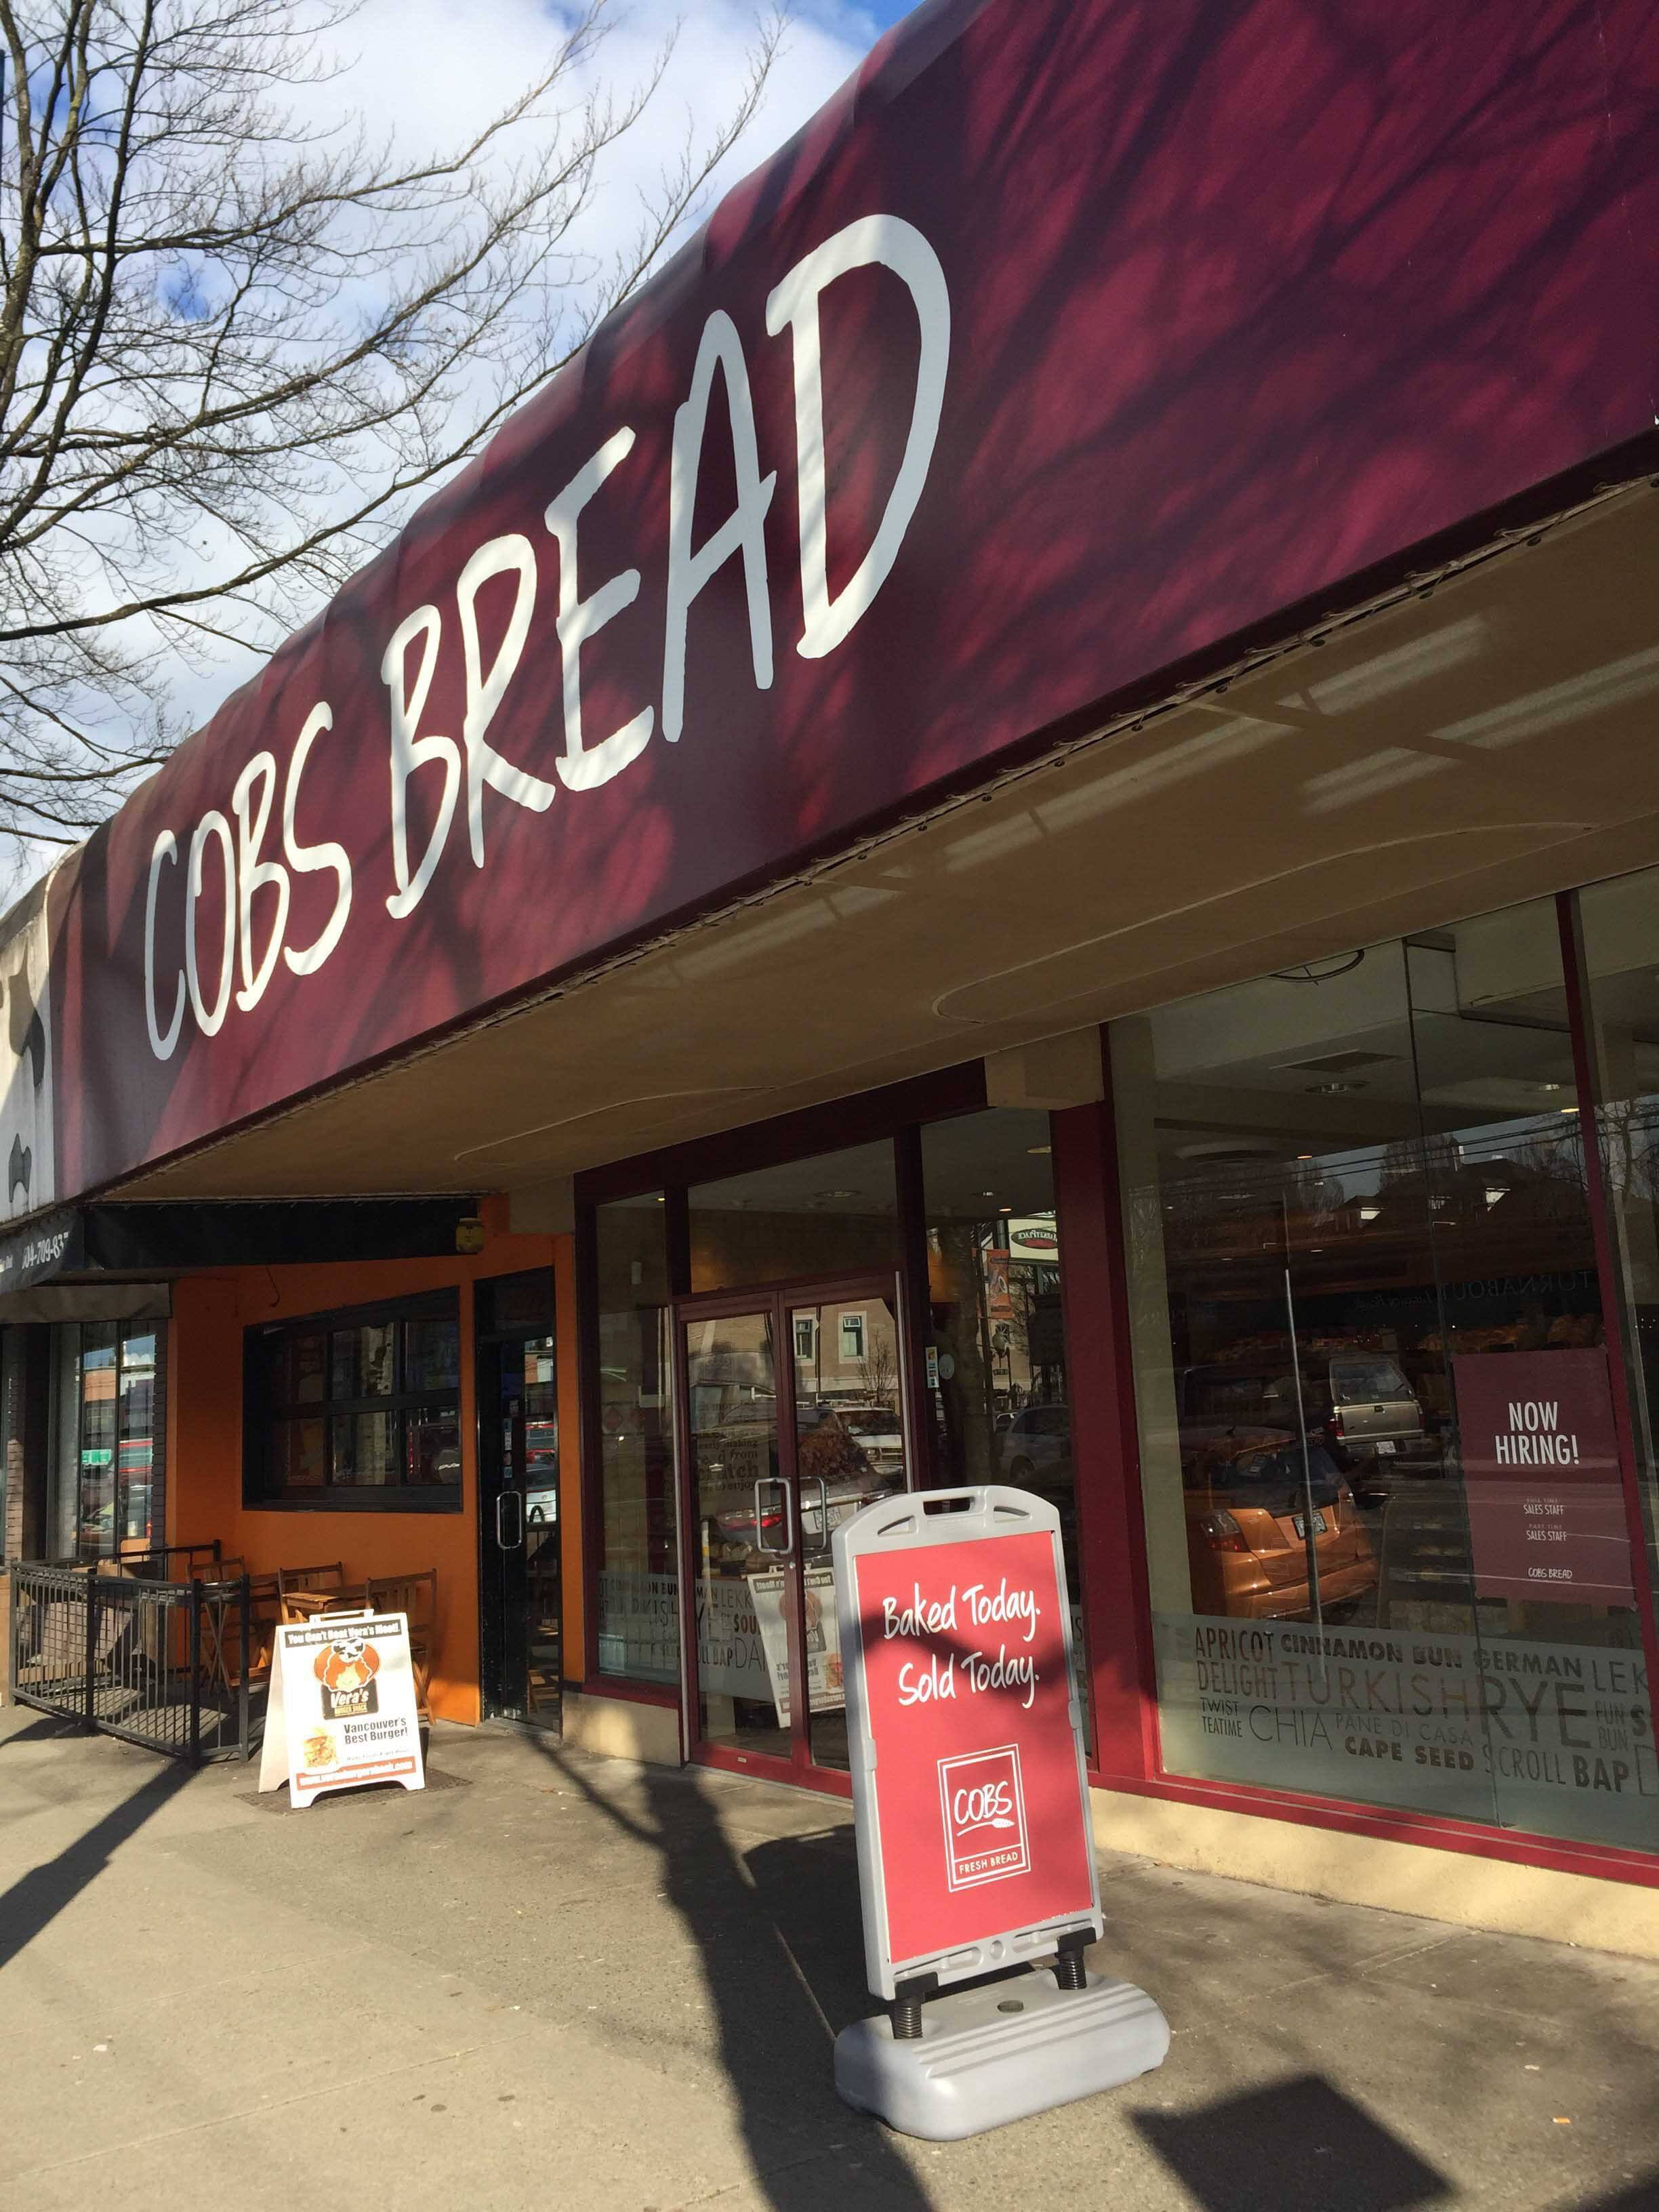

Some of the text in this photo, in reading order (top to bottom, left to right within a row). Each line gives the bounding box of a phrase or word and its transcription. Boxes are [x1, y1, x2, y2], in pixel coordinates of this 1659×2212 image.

[145, 213, 951, 1061] COBS BREAD
[1508, 1401, 1558, 1431] NOW
[730, 1448, 758, 1460] from
[1495, 1434, 1580, 1465] HIRING!
[1523, 1504, 1565, 1515] SALES STAFF
[1526, 1530, 1567, 1541] SALES STAFF
[1528, 1567, 1573, 1580] COBS BREAD
[734, 1613, 760, 1636] SOU
[882, 1582, 957, 1639] Baked
[962, 1578, 1041, 1643] Today.
[1195, 1626, 1275, 1663] APRICOT
[1281, 1634, 1403, 1663] CINNAMON
[1412, 1645, 1462, 1669] BUN
[1474, 1648, 1582, 1678] GERMAN
[898, 1644, 1040, 1708] Sold Today.
[331, 1689, 369, 1708] Vera's
[1197, 1660, 1278, 1701] DELIGHT
[1282, 1660, 1470, 1722] TURKISH
[1477, 1673, 1591, 1749] RYE
[1200, 1697, 1239, 1717] TWIST
[344, 1716, 407, 1734] Vancouver's
[345, 1726, 408, 1745] Best Burger!
[1202, 1715, 1243, 1738] TEATIME
[1249, 1704, 1333, 1750] CHIA
[1334, 1713, 1474, 1747] PANE DI CASA
[1344, 1735, 1475, 1771] CAPE SEED
[1482, 1744, 1567, 1786] SCROLL
[1572, 1753, 1630, 1794] BAP
[954, 1781, 1012, 1824] COBS
[959, 1851, 1019, 1875] FRESH BREAD
